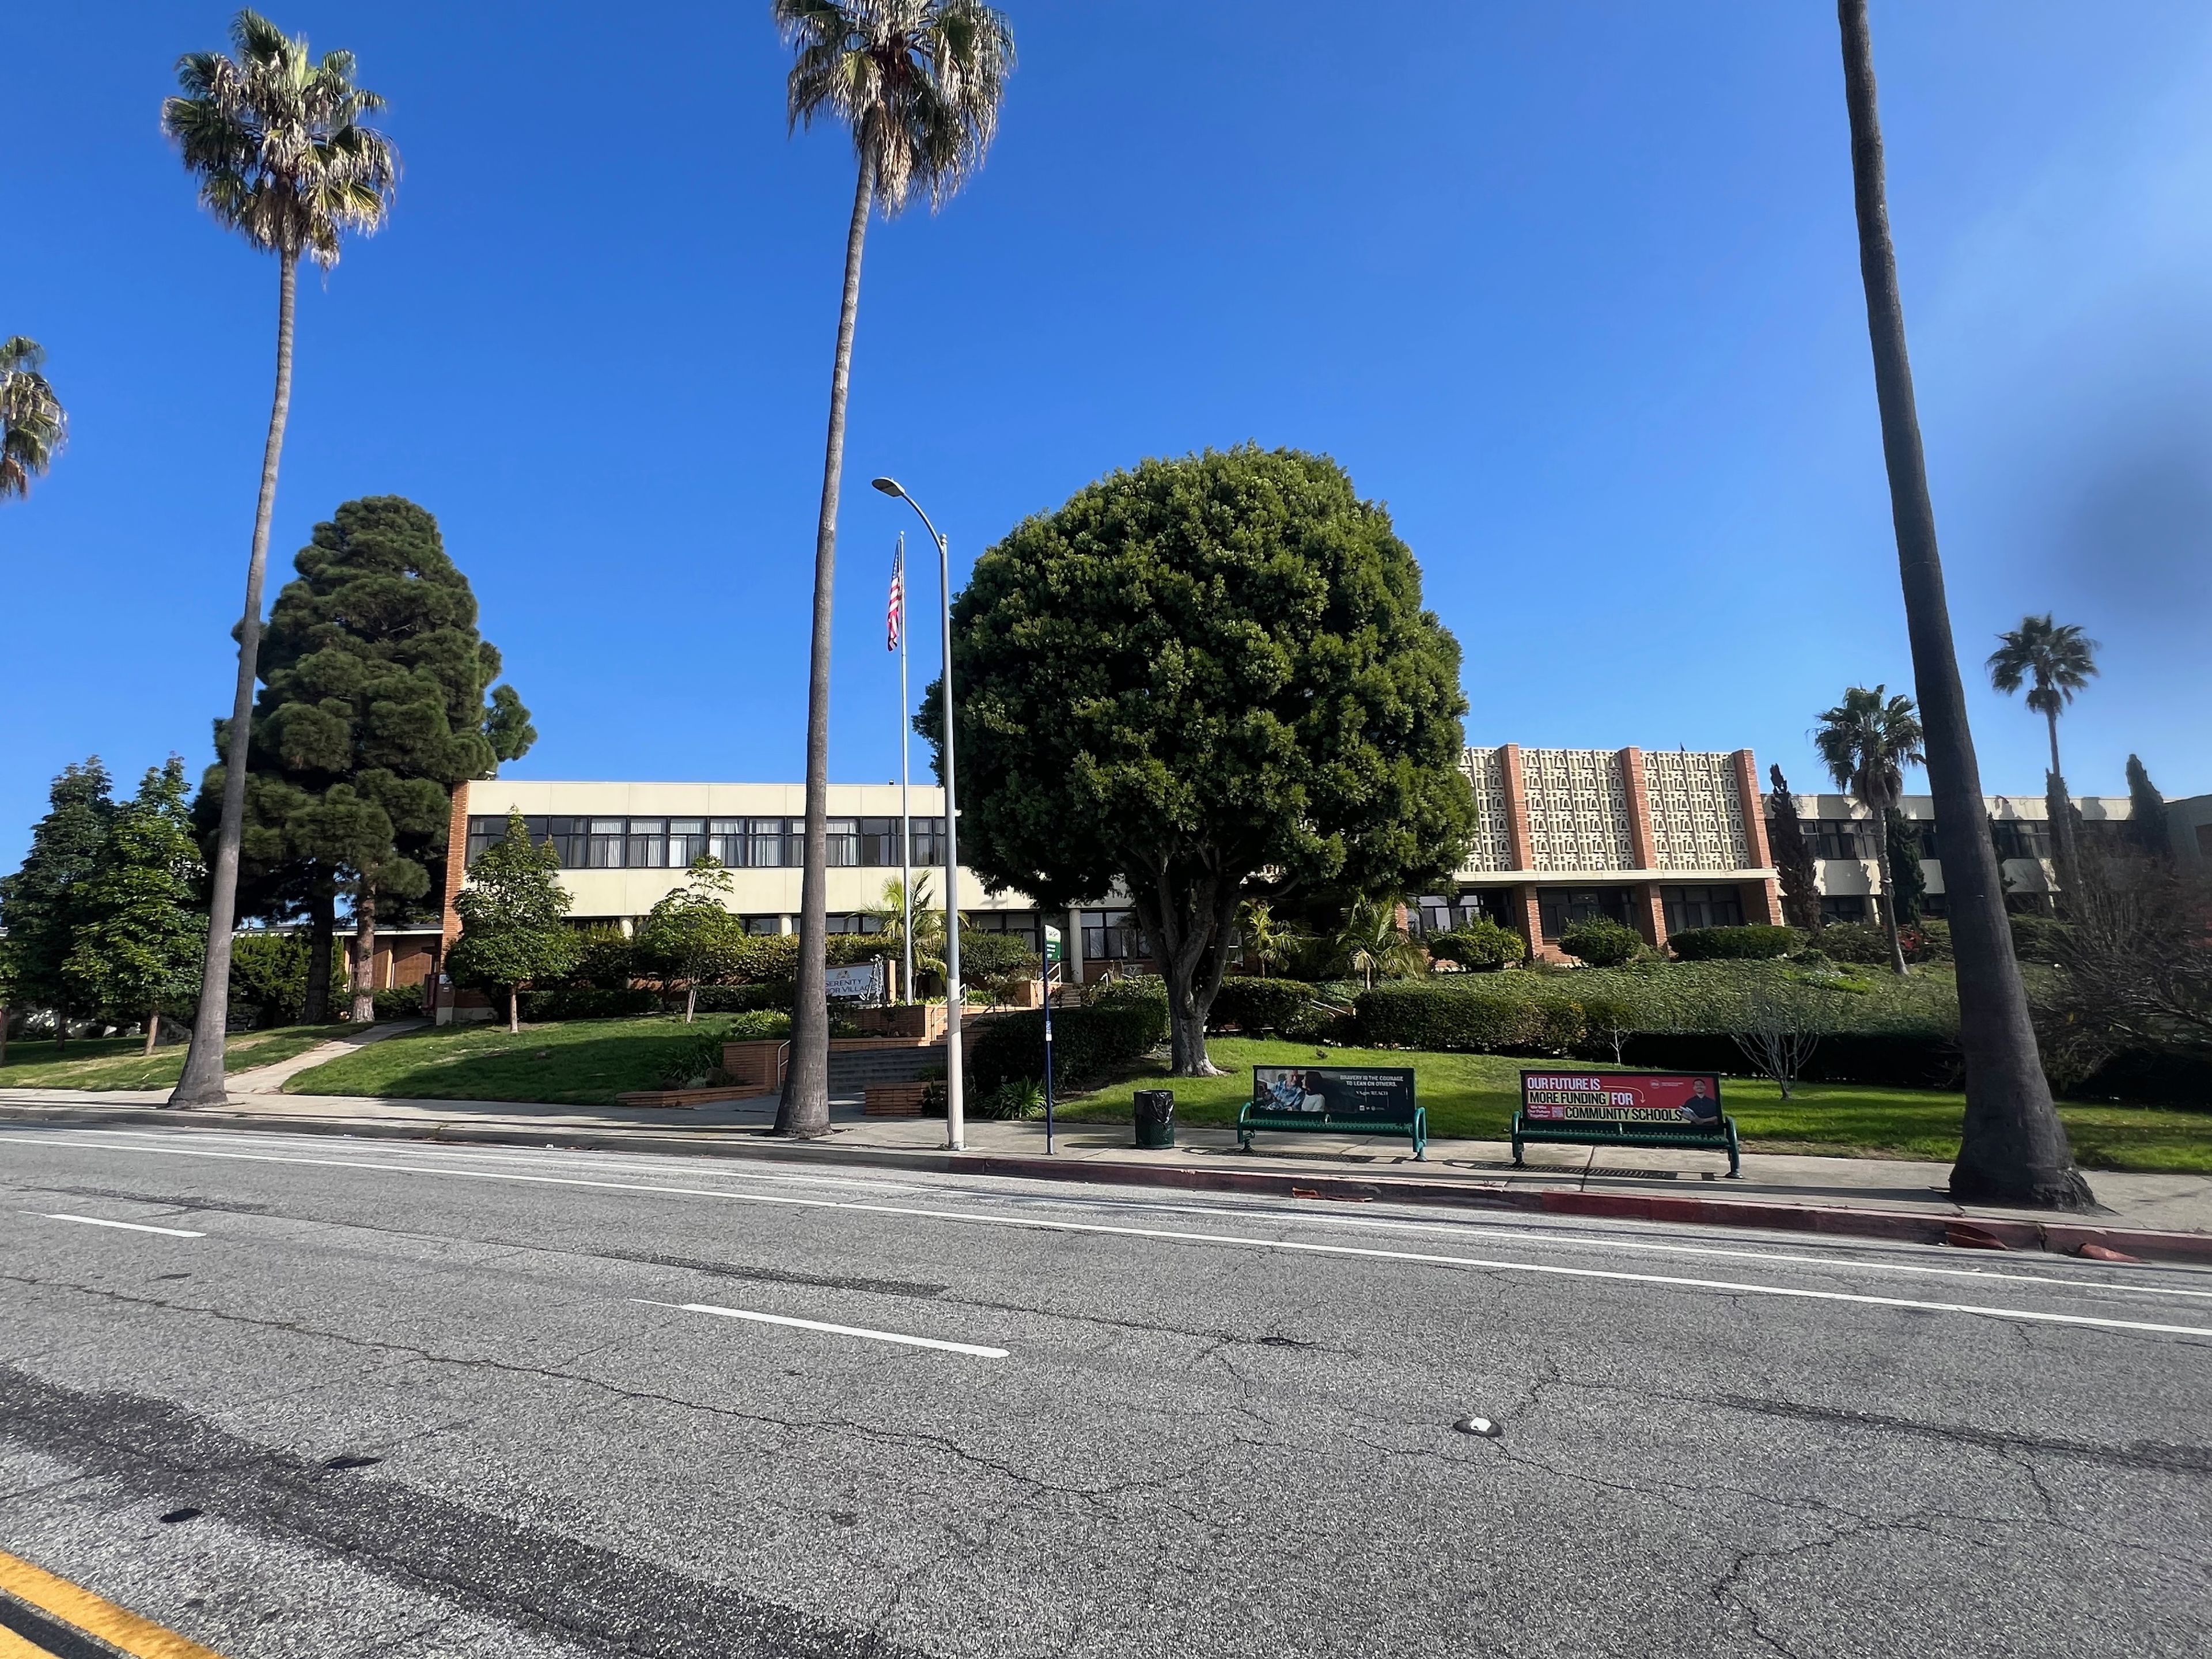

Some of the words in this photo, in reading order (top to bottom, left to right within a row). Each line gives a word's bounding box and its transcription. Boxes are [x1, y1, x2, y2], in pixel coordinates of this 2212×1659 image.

[825, 979, 862, 987] SERENITY
[1527, 1077, 1550, 1089] OUR
[1550, 1078, 1589, 1090] FUTURE
[1590, 1078, 1601, 1090] IS
[1530, 1092, 1559, 1103] MORE
[1560, 1092, 1606, 1104] FUNDING
[1611, 1092, 1634, 1105] FOR
[1565, 1107, 1629, 1120] COMMUNITY
[1631, 1108, 1682, 1121] SCHOOLS
